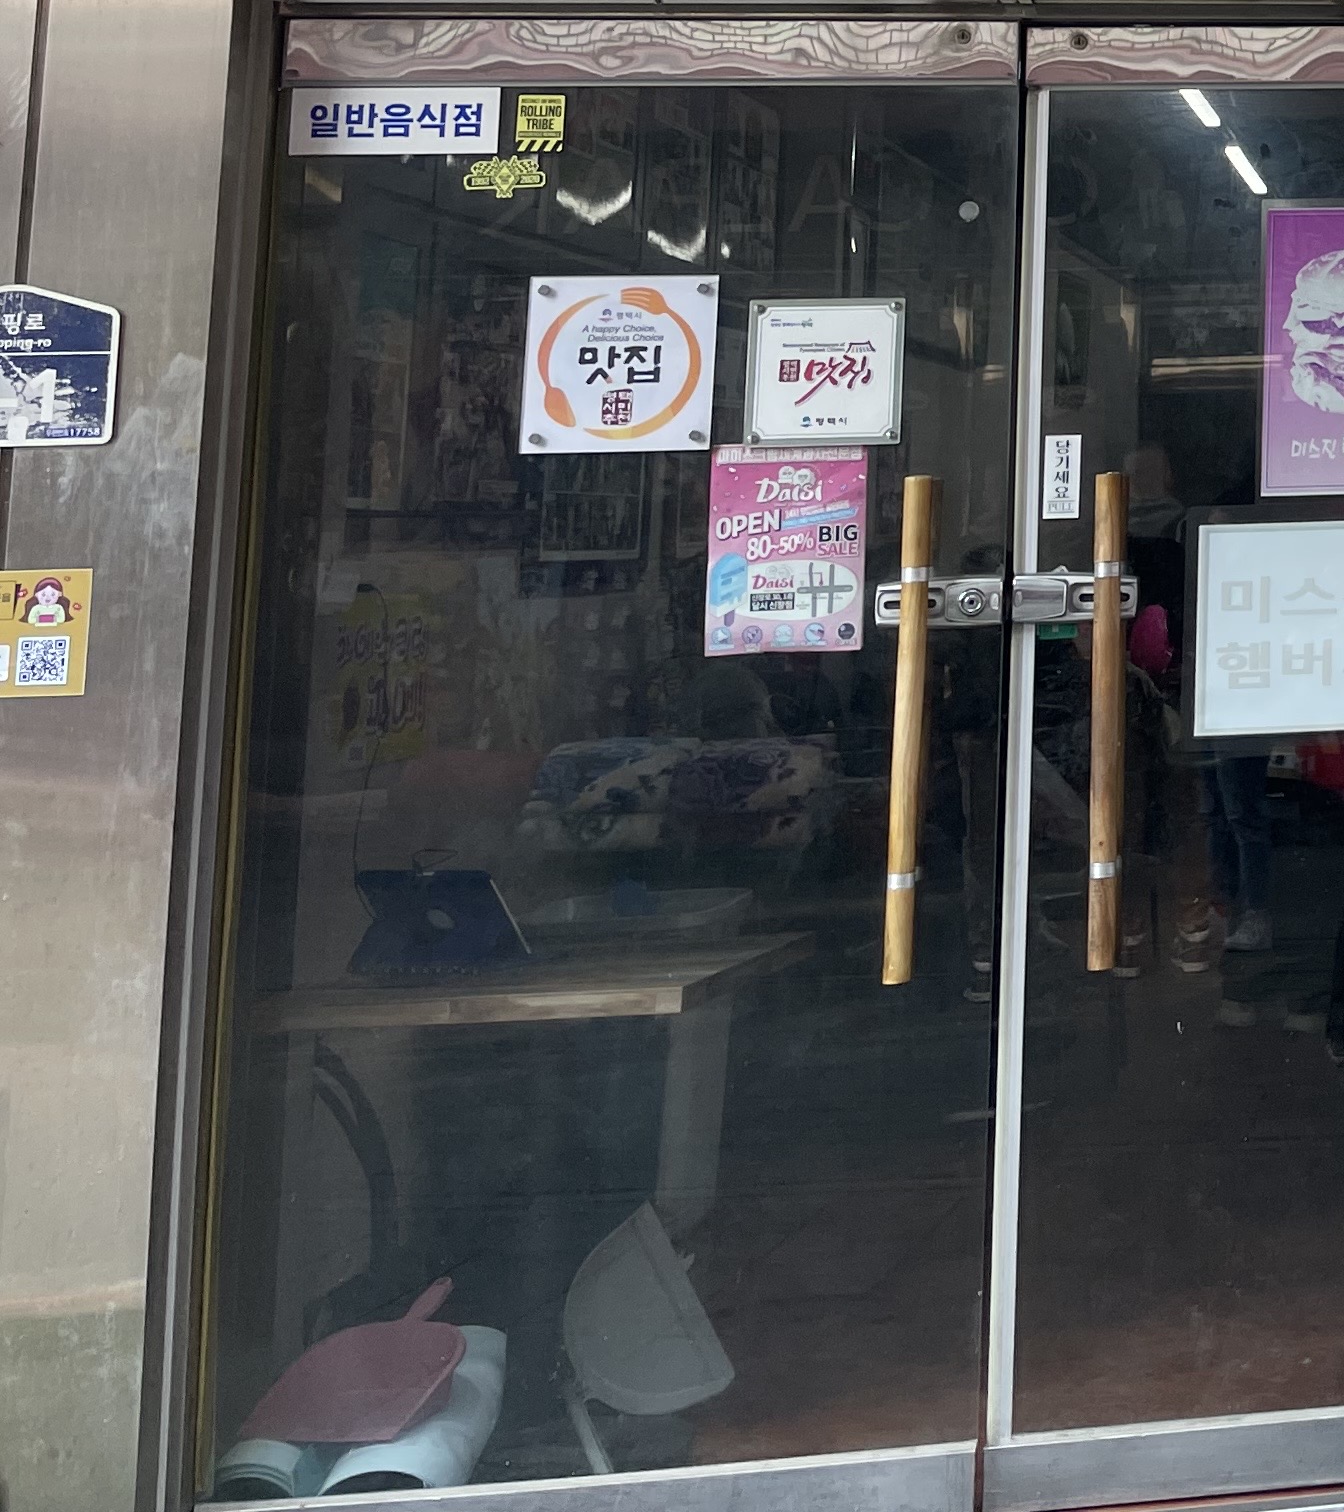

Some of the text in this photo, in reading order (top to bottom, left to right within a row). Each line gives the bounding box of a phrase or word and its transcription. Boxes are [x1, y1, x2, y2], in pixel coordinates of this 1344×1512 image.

[311, 103, 483, 138] 일반음식점
[520, 105, 561, 117] ROLLING
[526, 118, 554, 130] TRIBE
[579, 346, 661, 384] 맛집
[1054, 440, 1071, 498] 당기세요
[716, 508, 781, 540] OPEN
[818, 525, 858, 542] BIG
[818, 543, 857, 557] SALE
